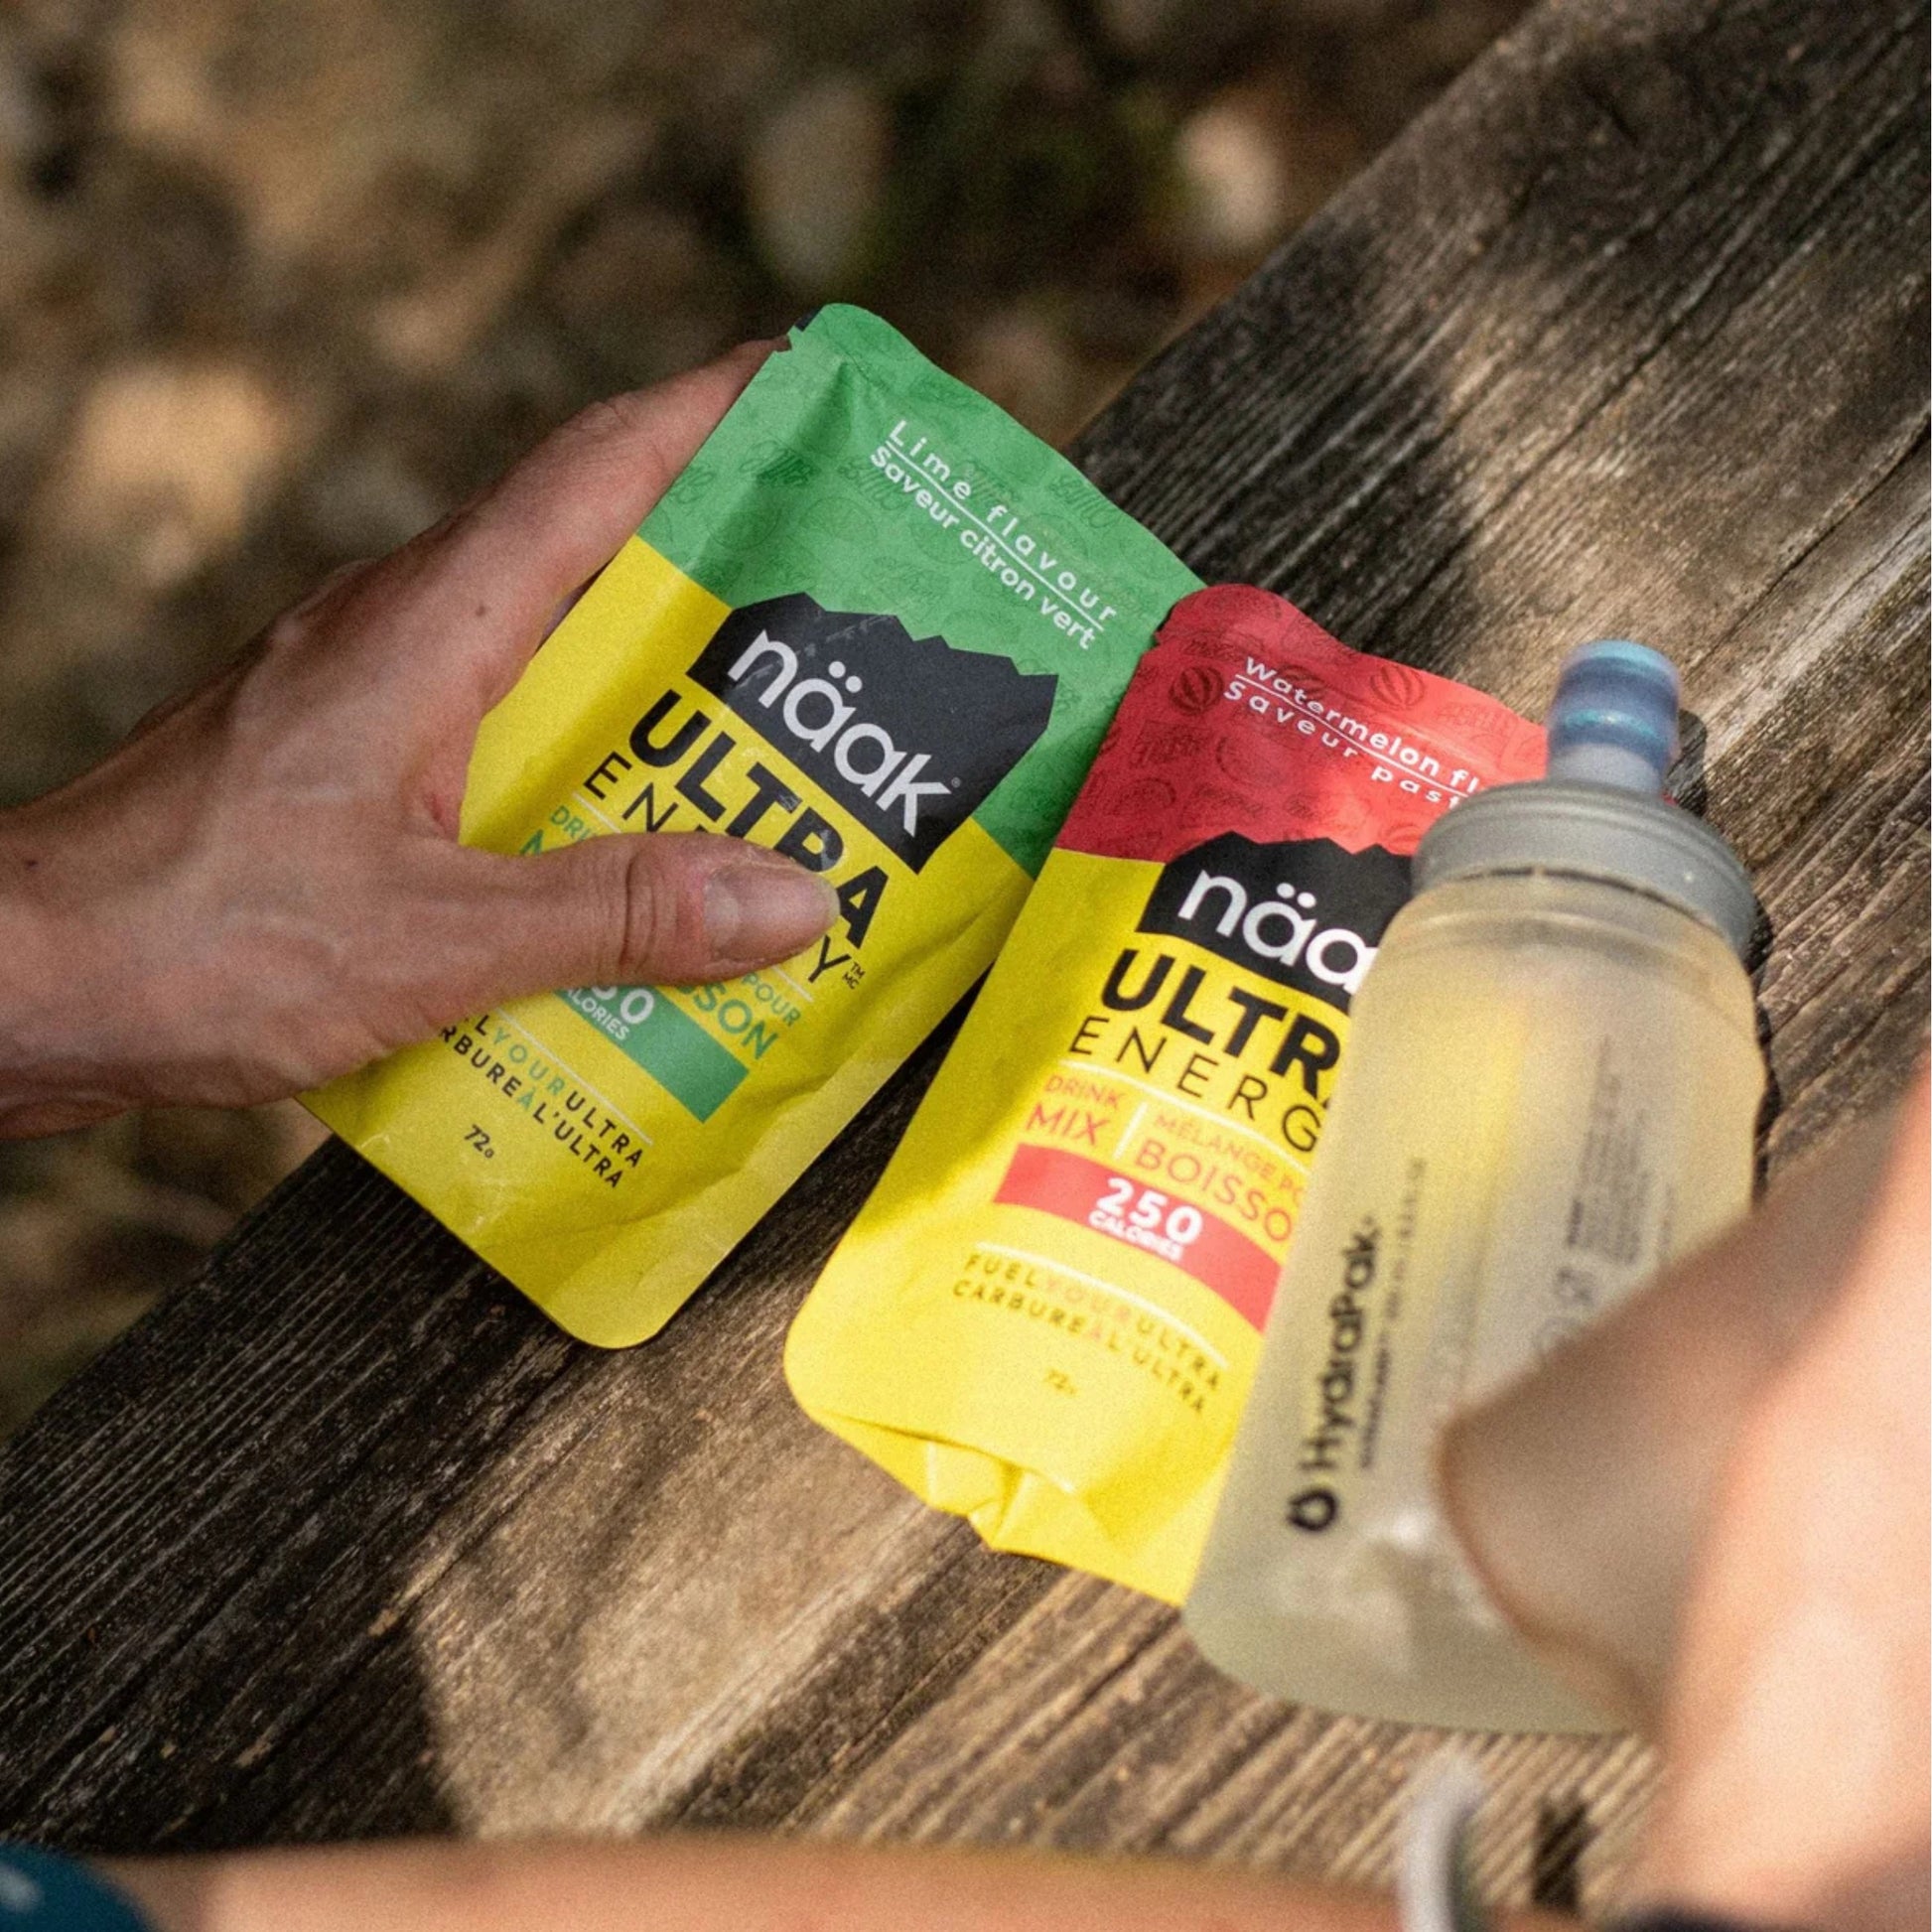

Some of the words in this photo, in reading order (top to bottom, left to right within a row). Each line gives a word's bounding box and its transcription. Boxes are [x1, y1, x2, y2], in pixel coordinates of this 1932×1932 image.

[871, 445, 960, 528] Saveur
[959, 529, 1035, 601] citron
[1039, 598, 1096, 649] vert
[890, 420, 972, 499] Lime
[987, 504, 1117, 623] flavour
[728, 629, 951, 838] näak
[1223, 681, 1358, 759] Saveur
[1371, 765, 1461, 809] past
[1246, 656, 1440, 777] Watermelon
[551, 805, 593, 842] DRI
[583, 751, 852, 984] ENY
[629, 689, 889, 950] ULTRA
[1177, 869, 1378, 996] näa
[569, 989, 630, 1041] LORIES
[742, 972, 801, 1028] POUR
[1101, 948, 1341, 1109] ULTR
[440, 1025, 522, 1099] RBURE
[532, 1102, 623, 1188] L'ULTRA
[493, 1027, 567, 1097] YOUR
[565, 1090, 643, 1169] ULTRA
[1027, 1101, 1109, 1146] MIX
[1045, 1075, 1122, 1111] DRINK
[1069, 1015, 1321, 1153] ENERG
[1089, 1207, 1184, 1262] CALORIES
[1097, 1177, 1204, 1245] 250
[1134, 1139, 1293, 1242] BOISSO
[952, 1278, 1086, 1335] CARBURE
[963, 1253, 1036, 1289] FUEL
[1135, 1314, 1220, 1392] ULTRA
[1298, 1225, 1383, 1472] HydraPak
